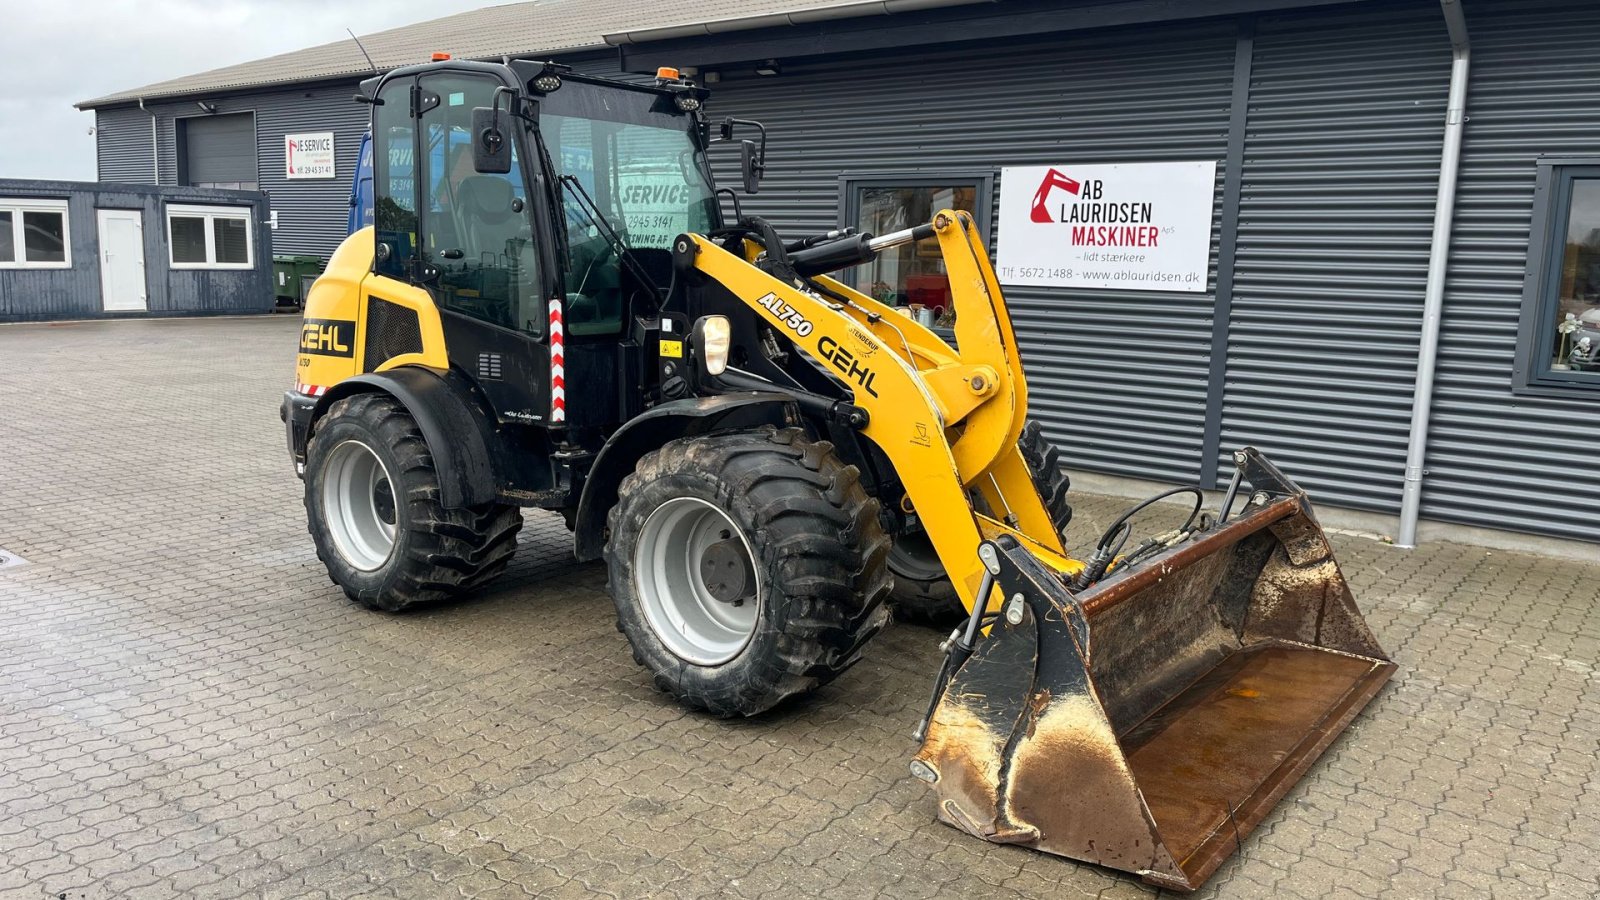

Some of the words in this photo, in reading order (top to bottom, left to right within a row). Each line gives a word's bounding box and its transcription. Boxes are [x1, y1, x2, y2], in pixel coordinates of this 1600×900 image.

[297, 140, 303, 151] JE
[304, 139, 330, 151] SERVICE
[305, 166, 311, 174] 29
[312, 166, 318, 174] 45
[318, 166, 324, 174] 31
[325, 166, 331, 174] 41
[623, 184, 689, 205] SERVICE
[1082, 180, 1103, 200] AB
[628, 215, 650, 228] 2945
[652, 215, 673, 228] 3141
[1060, 202, 1152, 223] LAURIDSEN
[657, 234, 668, 244] AF
[1072, 226, 1158, 247] MASKINER
[1161, 226, 1175, 234] ApS
[1083, 251, 1098, 262] lidt
[1101, 252, 1146, 263] stærkere
[1002, 267, 1015, 279] Tlf.
[1020, 268, 1045, 279] 5672
[1048, 268, 1073, 279] 1488
[1082, 268, 1199, 283] www.ablauridsen.dk
[756, 291, 814, 338] AL750
[301, 323, 348, 352] GEHL
[817, 336, 879, 399] GEHL
